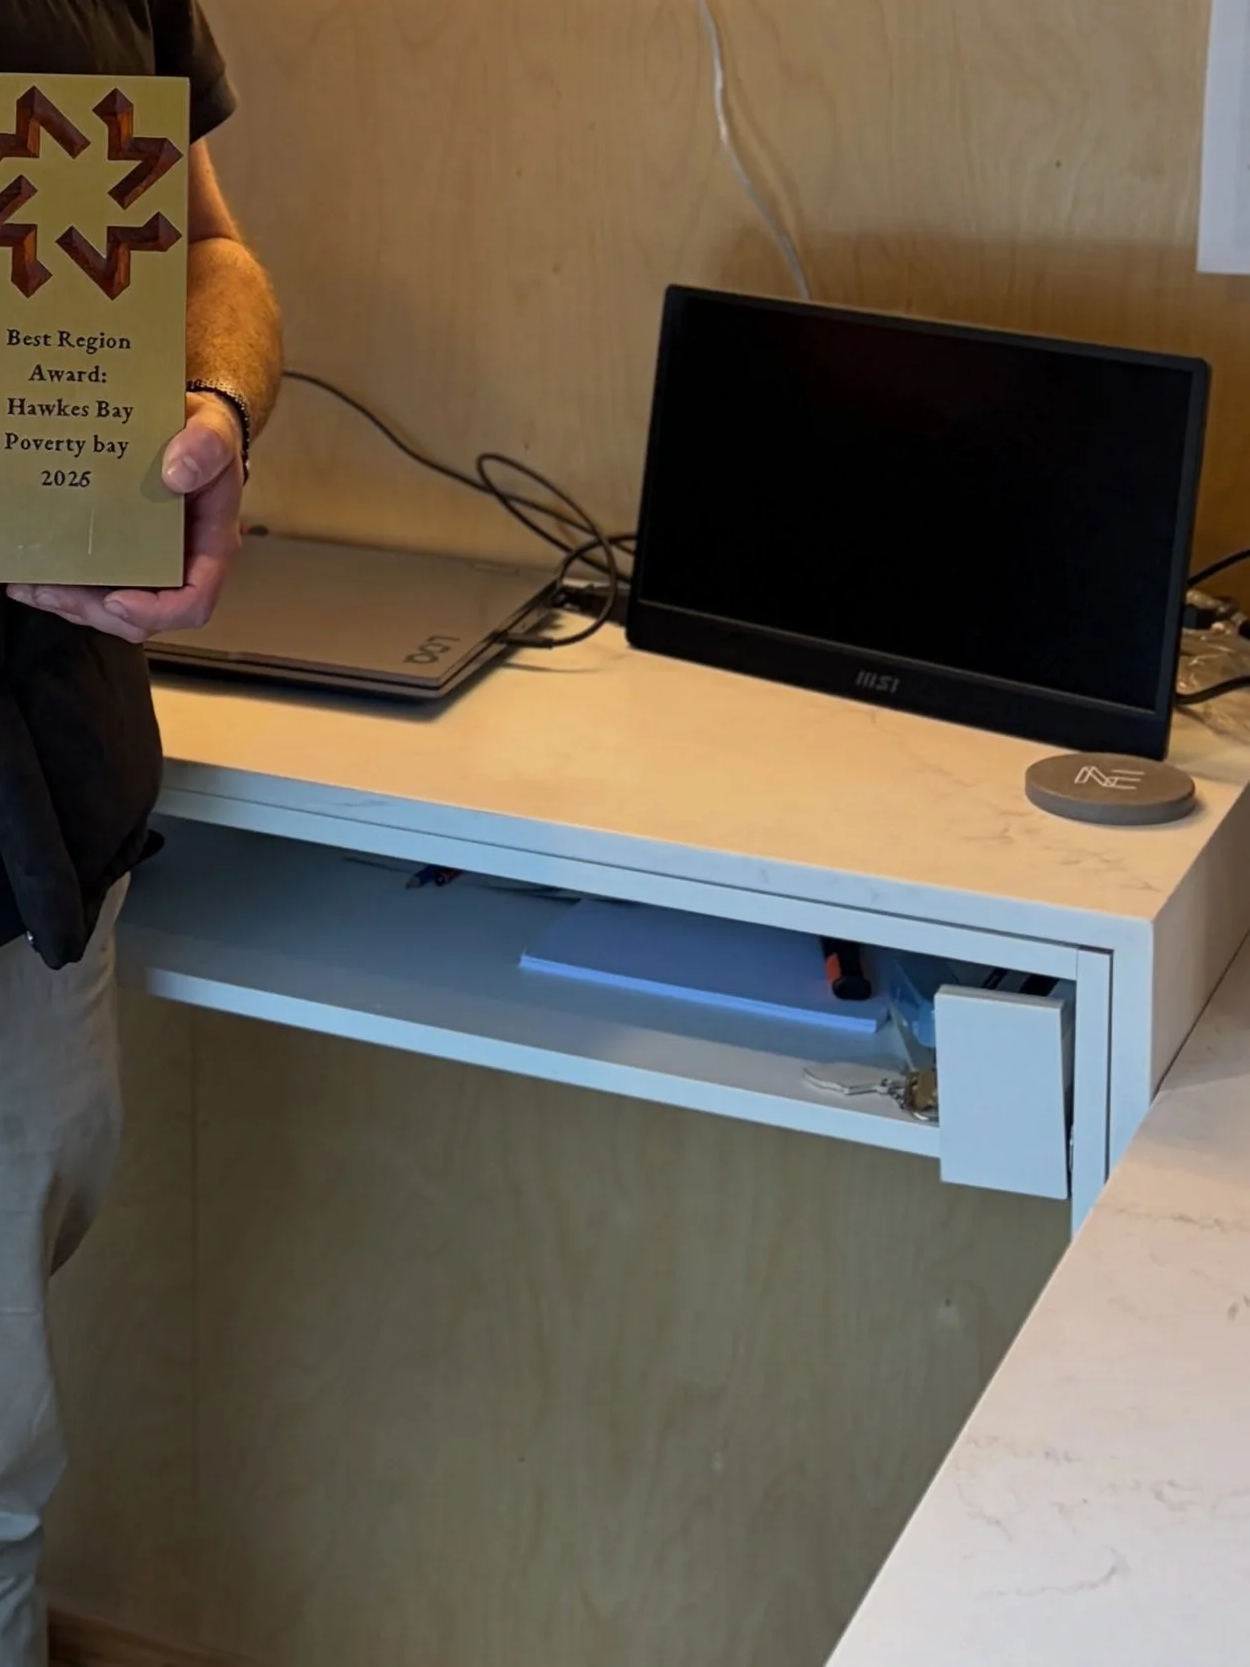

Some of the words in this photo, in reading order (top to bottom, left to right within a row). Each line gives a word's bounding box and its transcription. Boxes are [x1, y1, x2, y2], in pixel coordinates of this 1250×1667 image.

[6, 328, 51, 347] Best
[57, 330, 131, 355] Region
[28, 363, 107, 384] Award:
[7, 397, 89, 417] Hawkes
[95, 400, 134, 424] Bay
[4, 432, 86, 458] Poverty
[93, 434, 129, 459] bay
[40, 469, 92, 488] 2026
